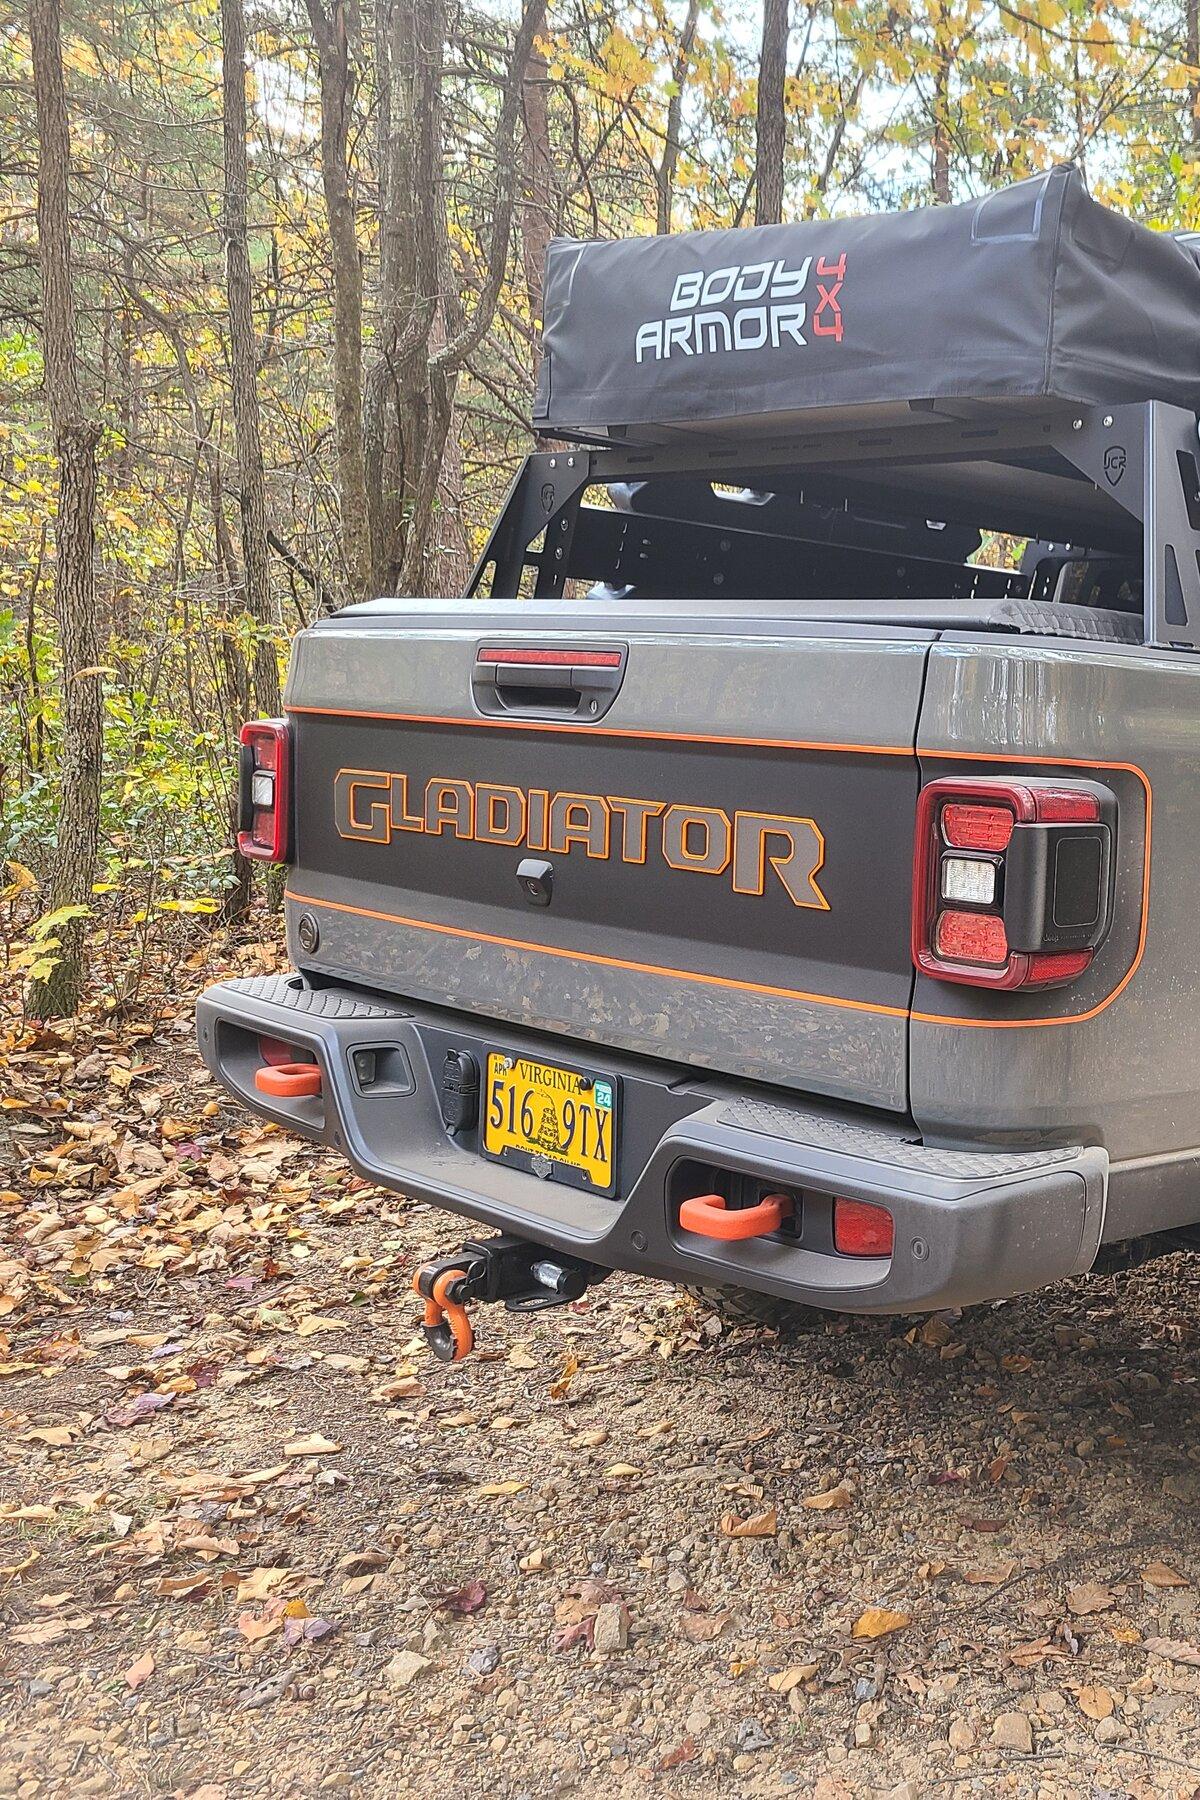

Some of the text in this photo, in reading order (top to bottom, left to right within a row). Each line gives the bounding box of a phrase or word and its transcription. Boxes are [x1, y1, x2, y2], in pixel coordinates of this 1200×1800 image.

[669, 256, 813, 311] BODY
[635, 302, 808, 363] ARMOR
[334, 767, 831, 911] GLADIATOR
[519, 1062, 583, 1096] VIRGINIA
[596, 1090, 612, 1107] 24
[489, 1080, 609, 1164] 516 9TX
